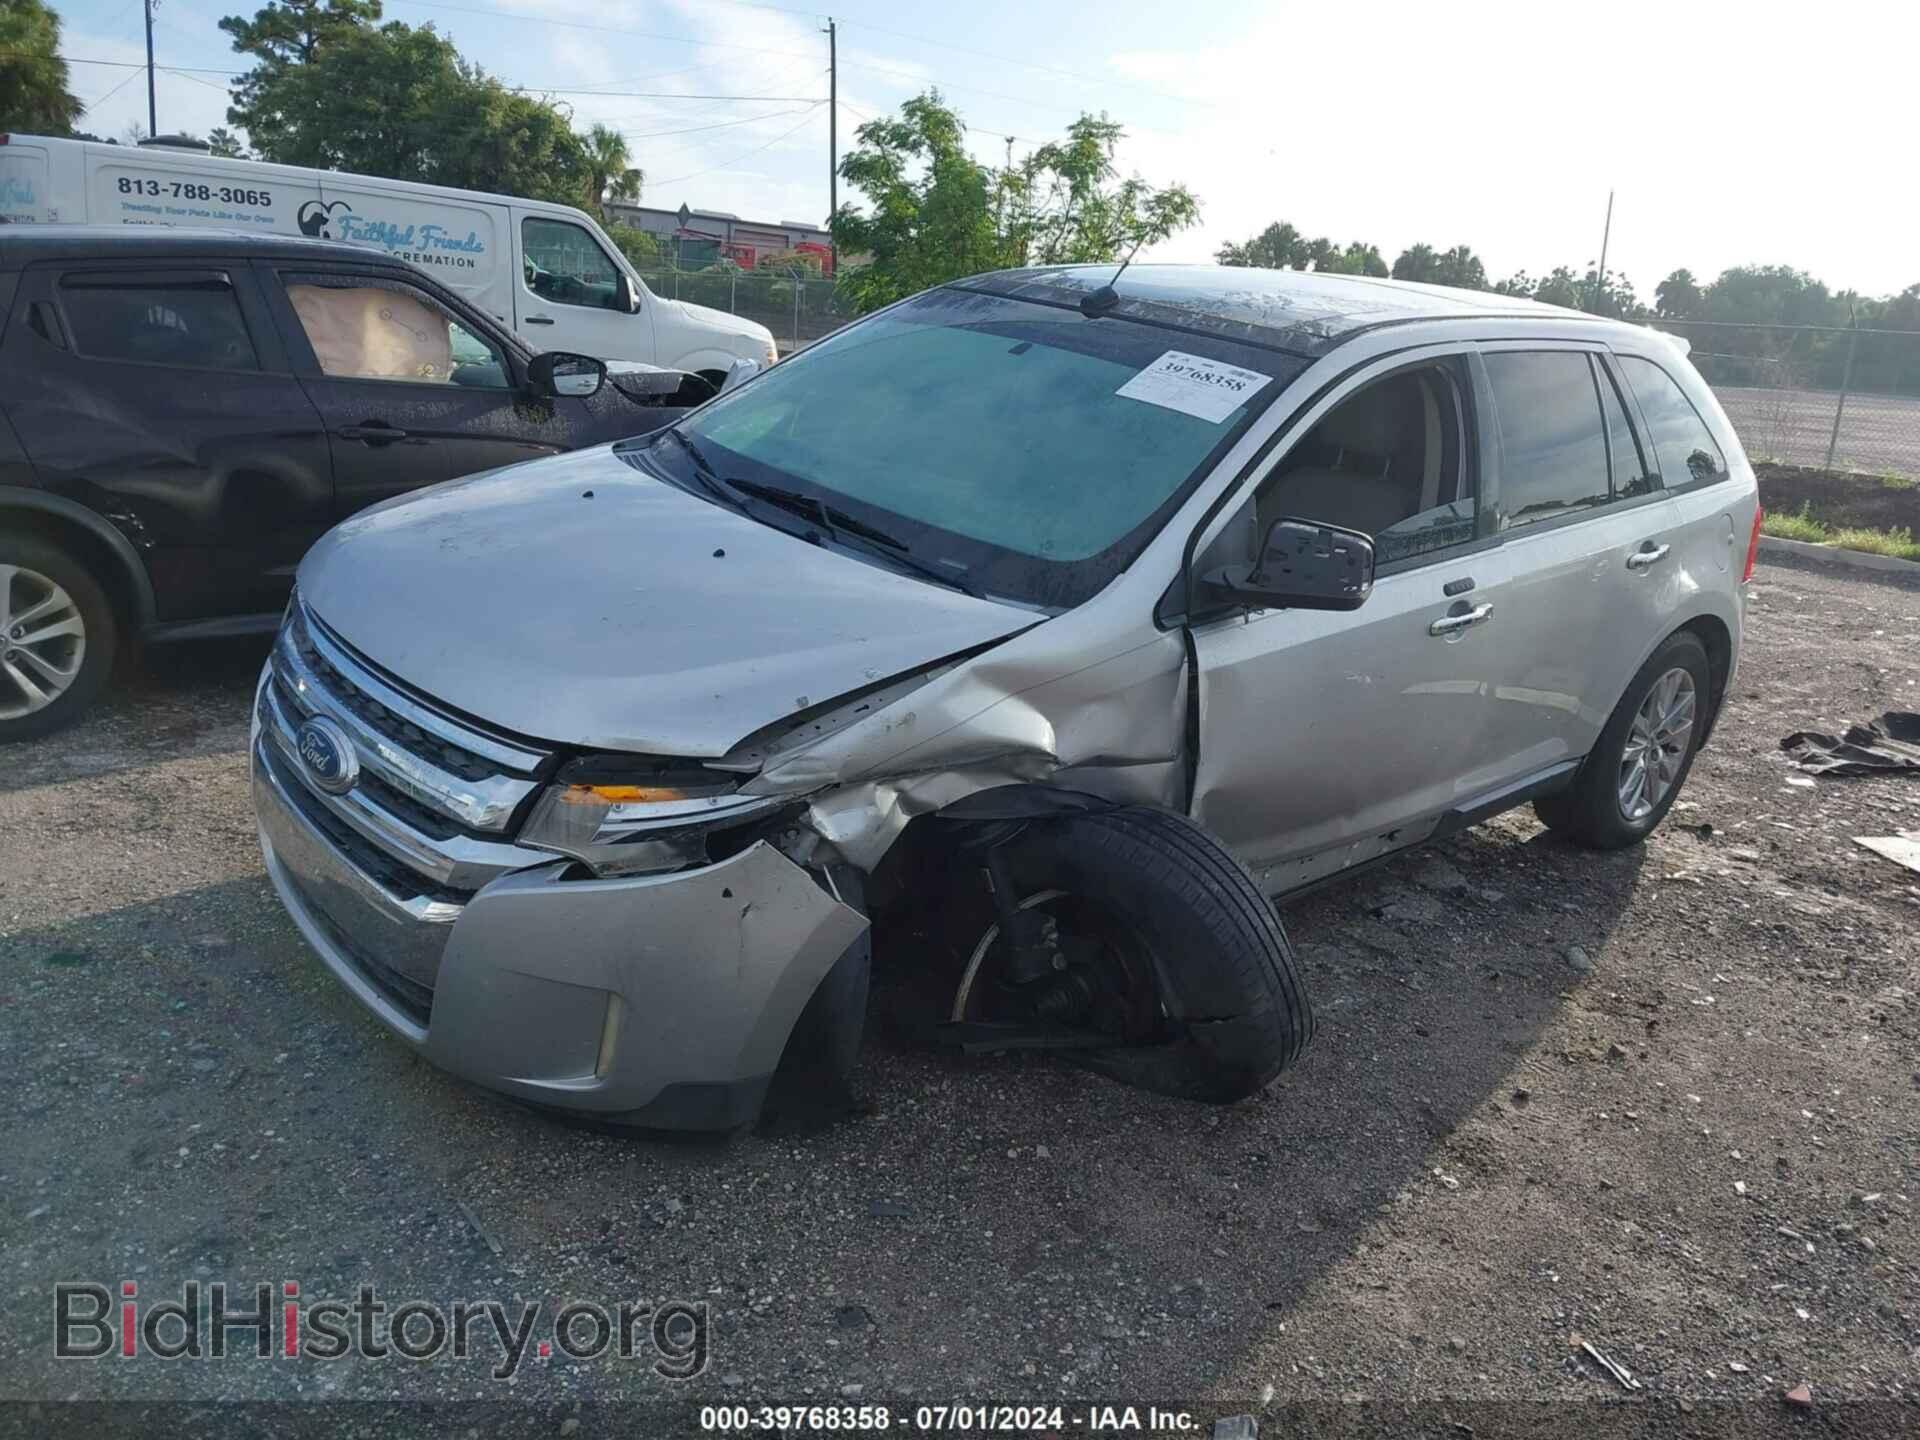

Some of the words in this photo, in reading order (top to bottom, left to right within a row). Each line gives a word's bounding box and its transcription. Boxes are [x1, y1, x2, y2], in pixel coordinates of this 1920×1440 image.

[118, 177, 272, 207] 813-788-3065
[165, 206, 187, 216] Your
[213, 210, 233, 220] Like
[235, 213, 252, 221] Our
[338, 215, 414, 249] Faithful
[416, 224, 484, 253] Friends
[1160, 362, 1246, 391] 39768358
[301, 732, 330, 771] Ford
